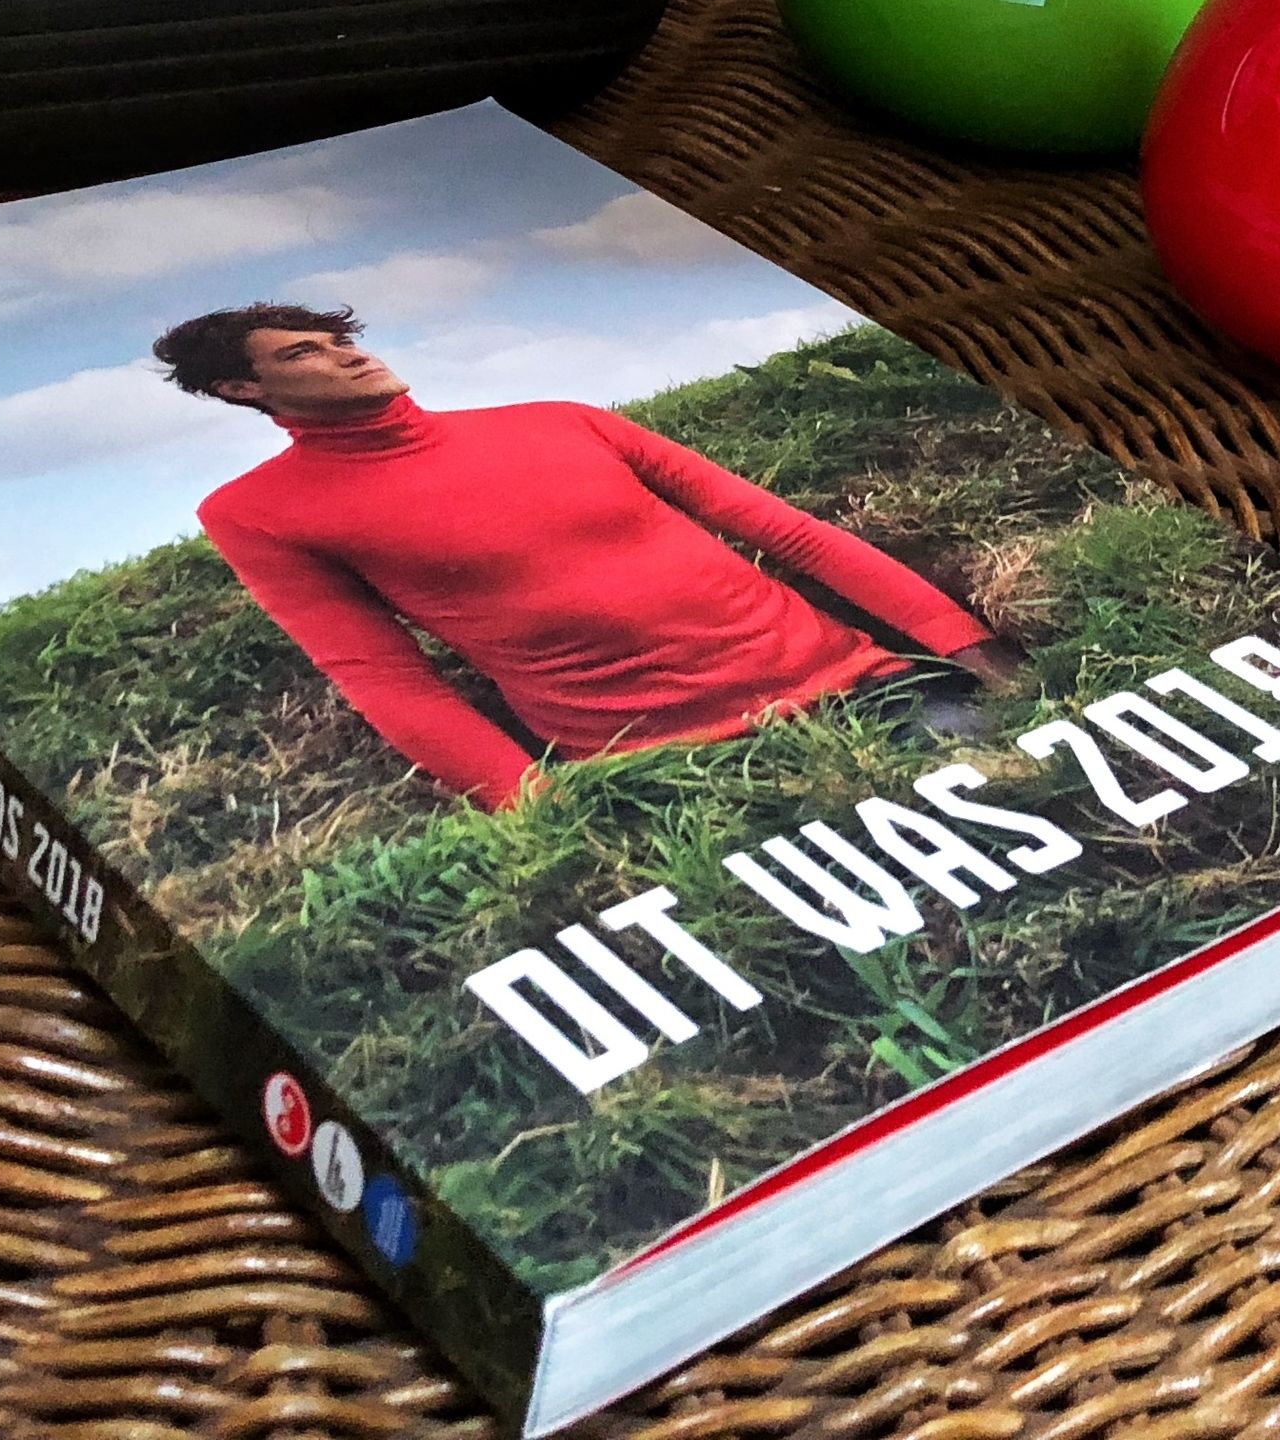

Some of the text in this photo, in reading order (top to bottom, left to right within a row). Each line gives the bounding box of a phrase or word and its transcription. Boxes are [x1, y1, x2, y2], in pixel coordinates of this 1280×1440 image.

[27, 822, 104, 945] 2018
[465, 885, 764, 1094] DIT
[723, 762, 1083, 954] WAS
